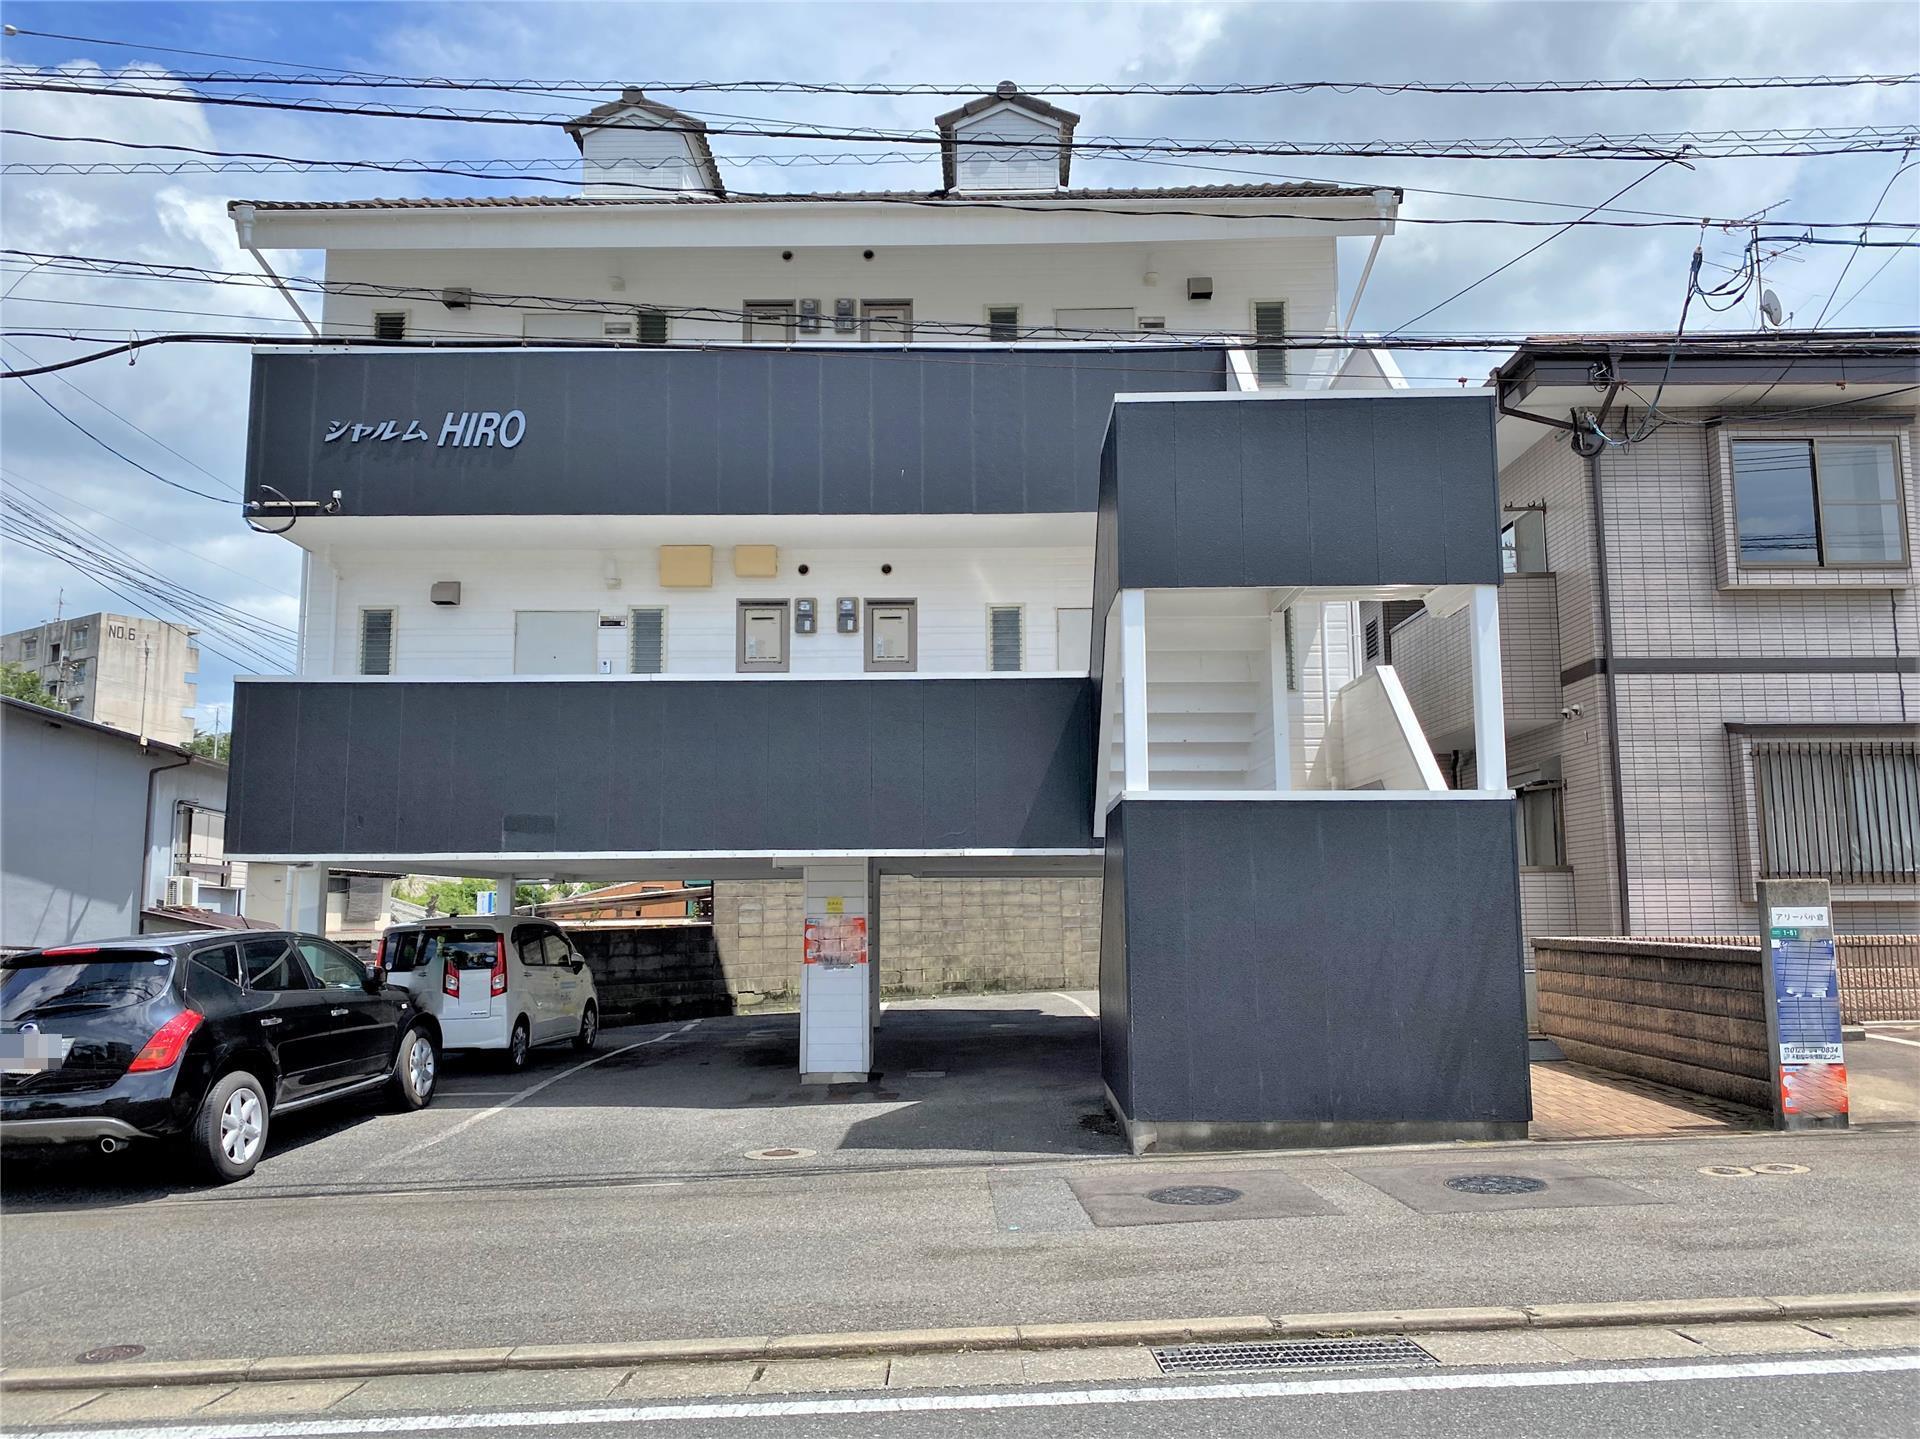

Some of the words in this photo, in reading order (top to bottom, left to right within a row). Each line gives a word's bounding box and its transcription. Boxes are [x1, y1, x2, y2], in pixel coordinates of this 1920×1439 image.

[324, 420, 428, 442] シャルム
[437, 409, 526, 448] HIRO
